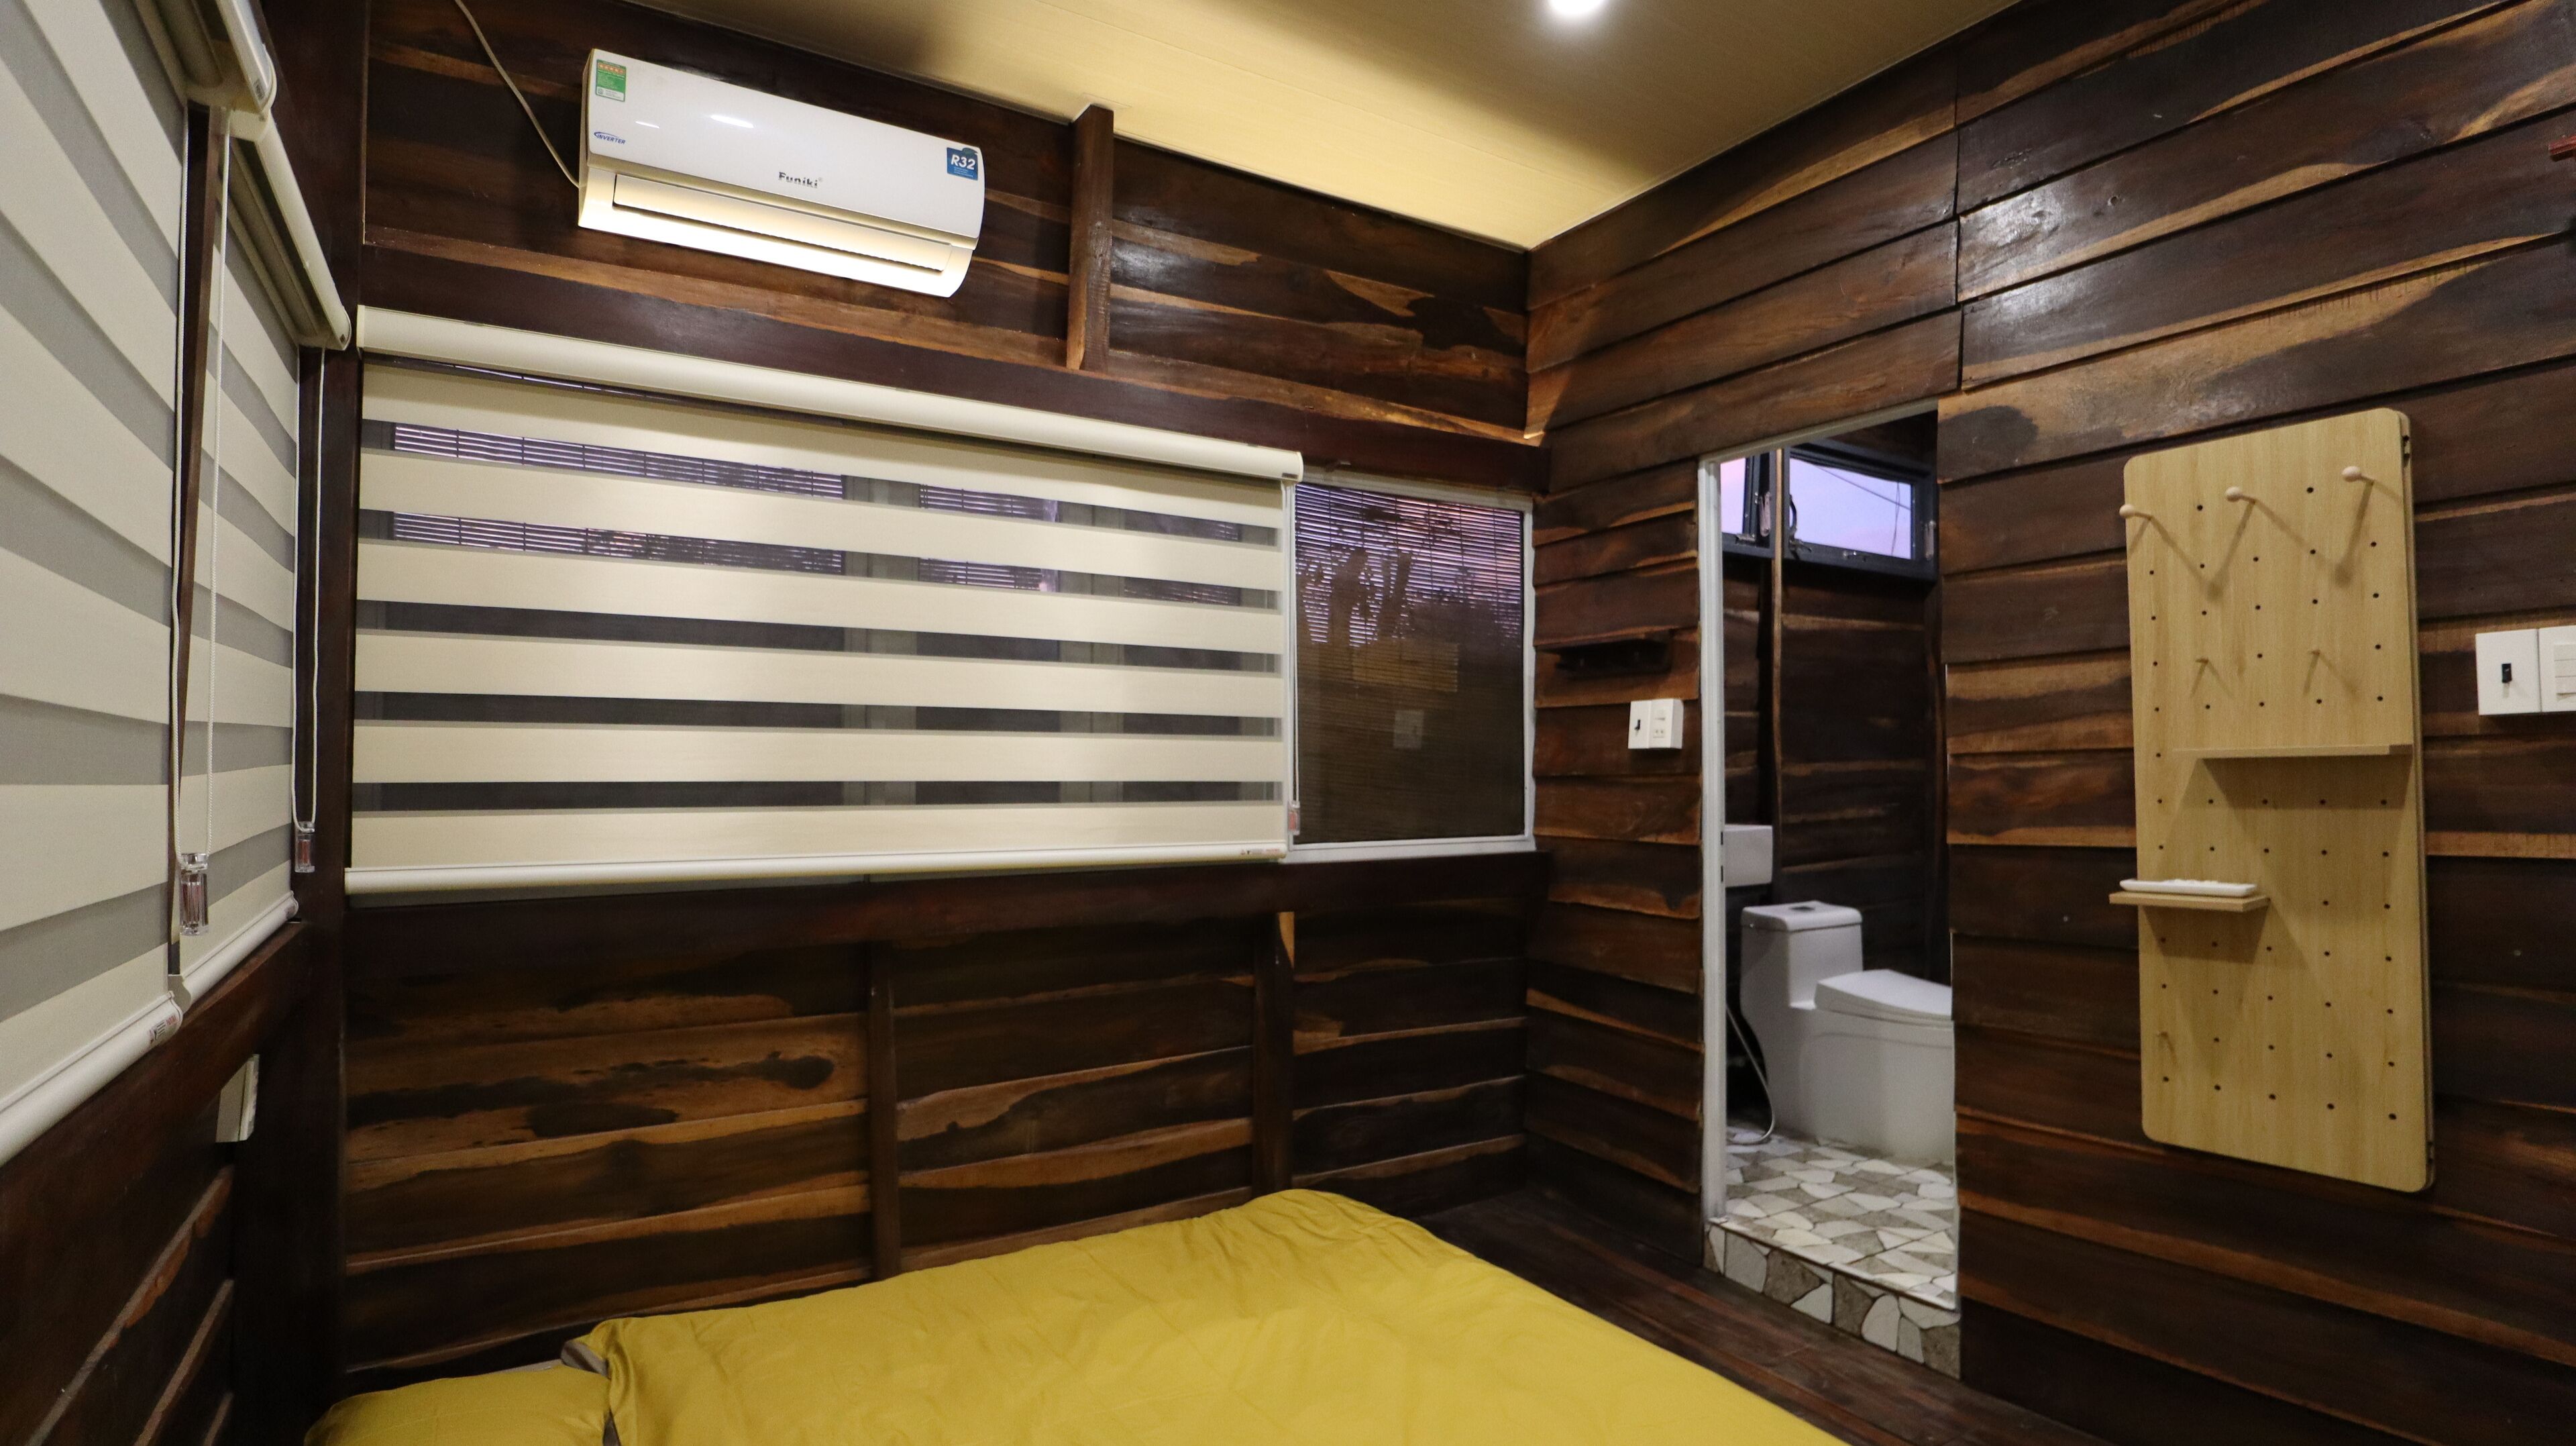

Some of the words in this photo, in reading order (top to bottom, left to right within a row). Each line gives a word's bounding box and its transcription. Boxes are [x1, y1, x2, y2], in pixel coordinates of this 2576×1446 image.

[596, 134, 626, 145] INVERTER
[951, 154, 975, 170] R32
[779, 172, 818, 189] Funiki
